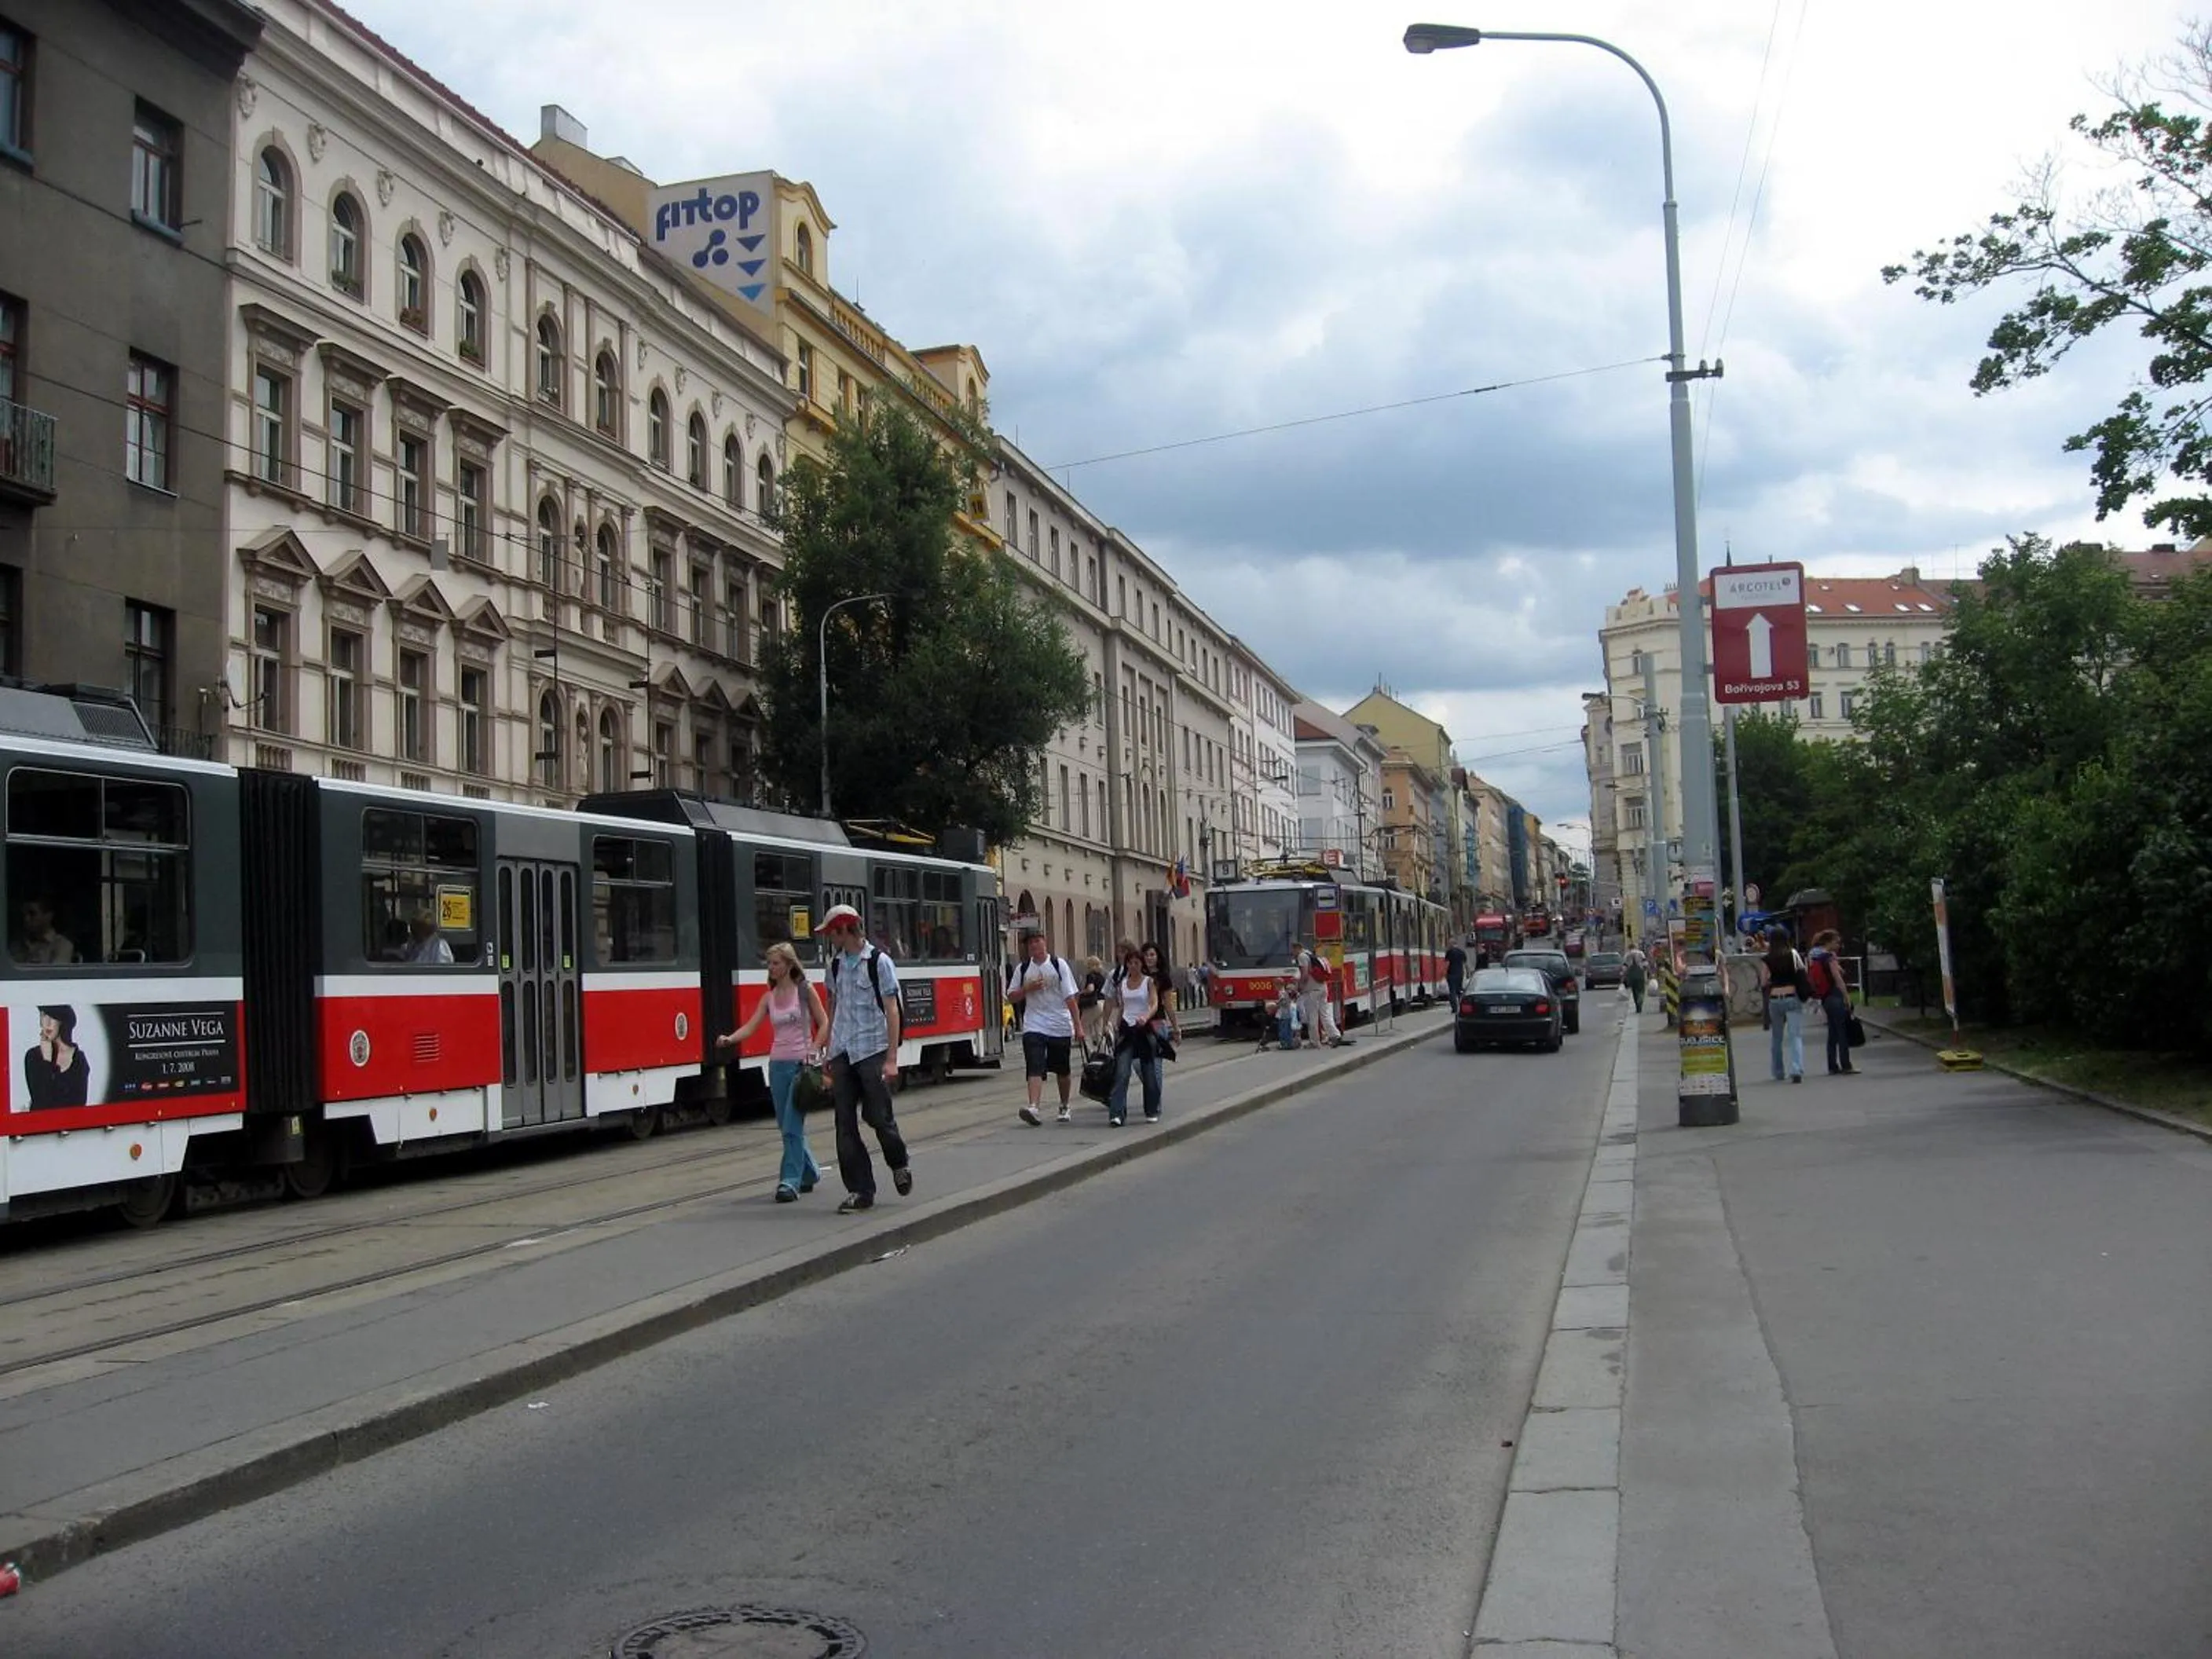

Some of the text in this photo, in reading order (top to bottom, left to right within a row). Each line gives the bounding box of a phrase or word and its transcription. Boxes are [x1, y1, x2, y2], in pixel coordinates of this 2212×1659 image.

[1730, 581, 1782, 593] ARCOTEL
[1786, 680, 1800, 690] 53
[129, 1019, 224, 1039] SUZANNE VEGA
